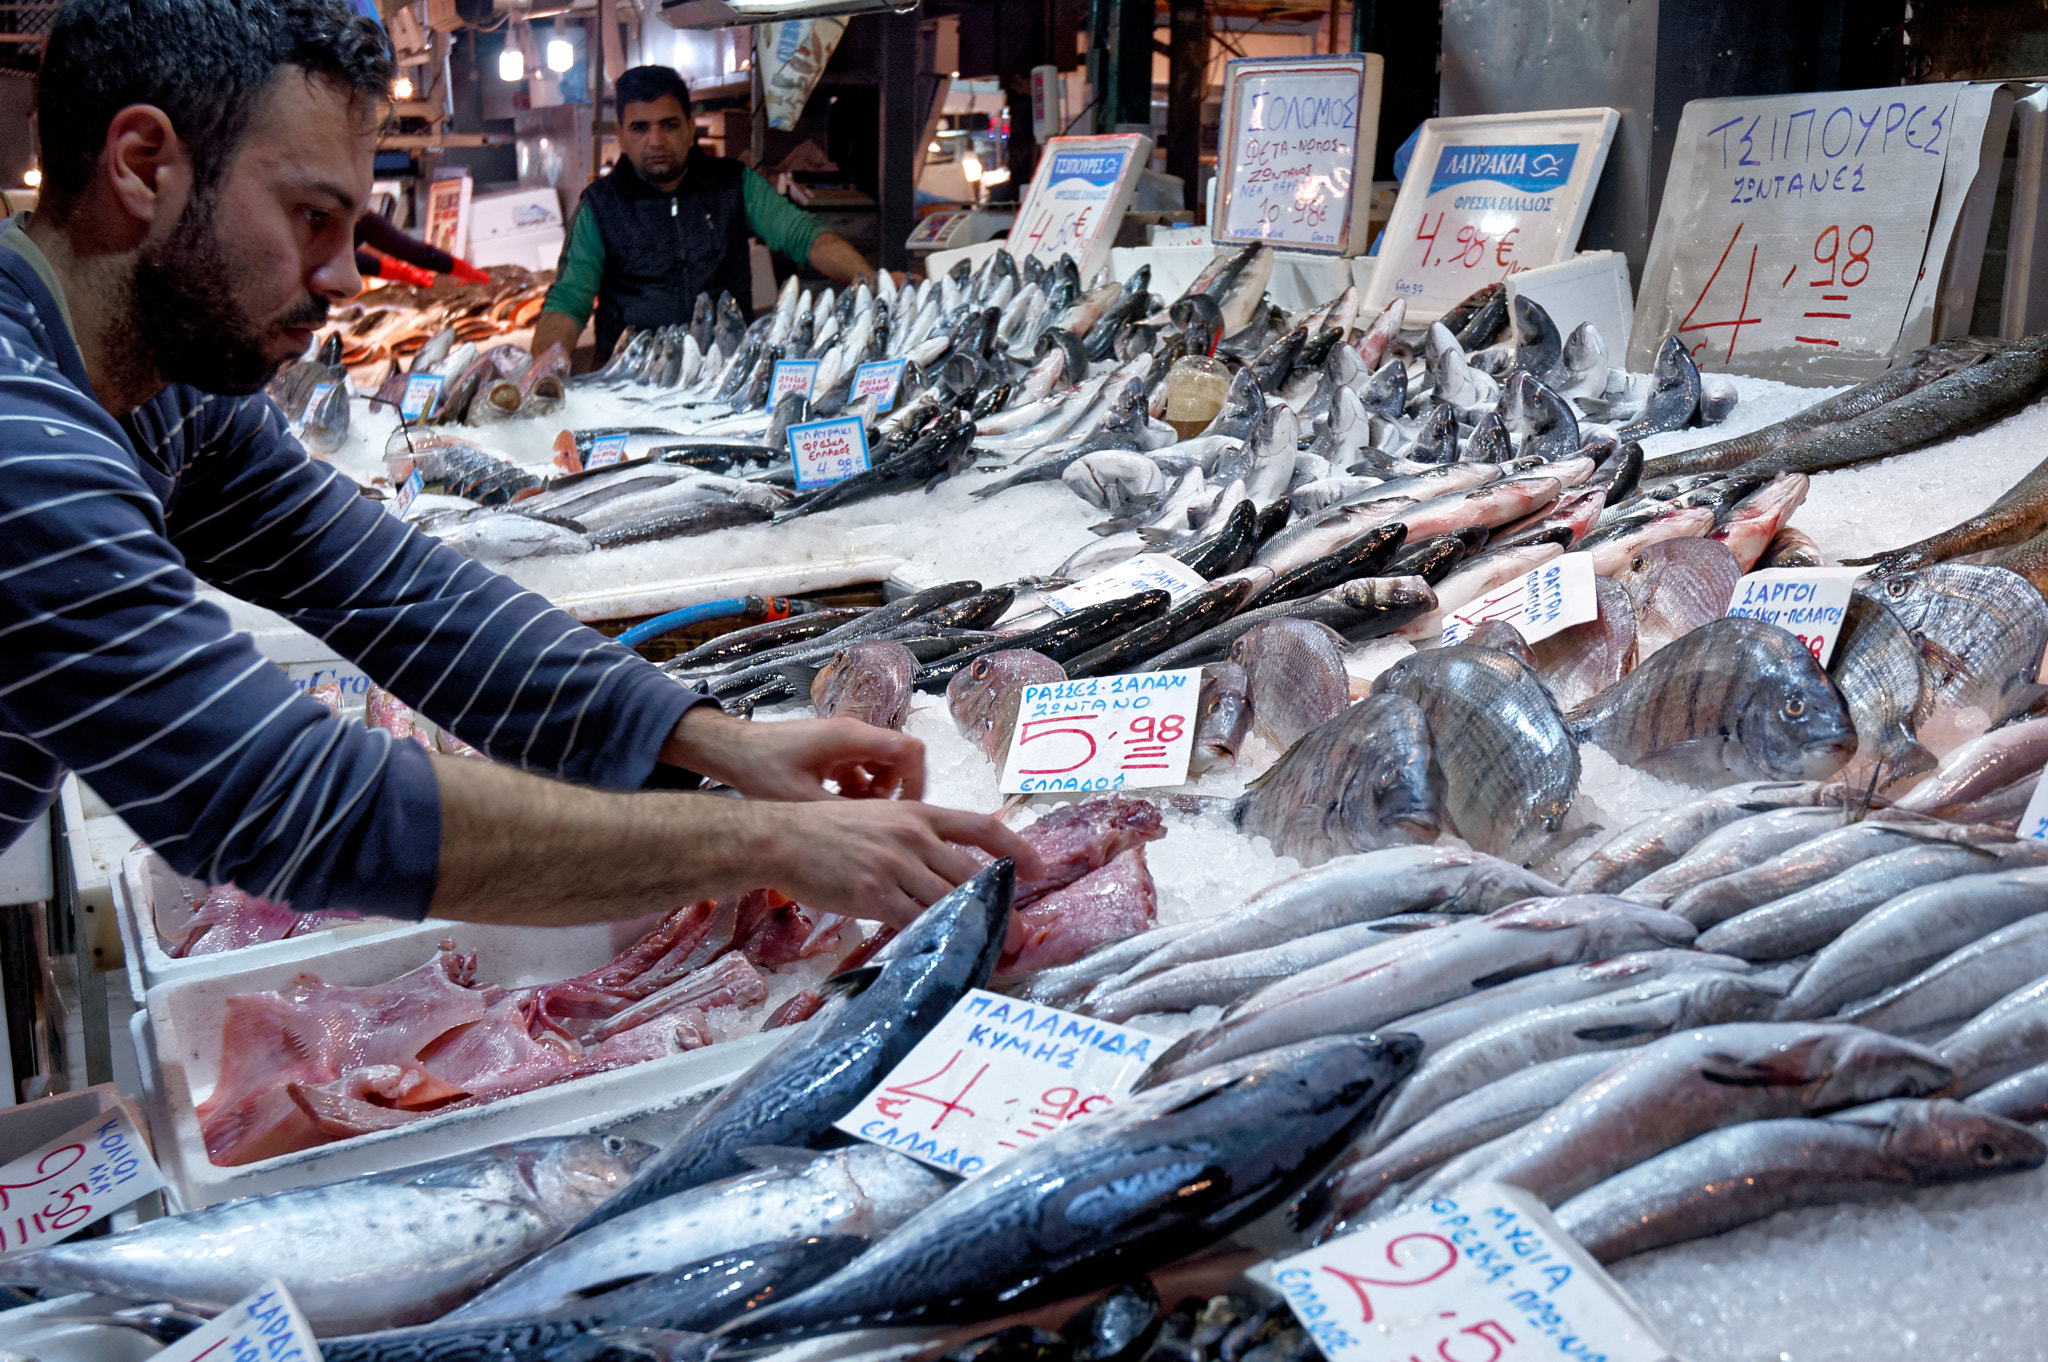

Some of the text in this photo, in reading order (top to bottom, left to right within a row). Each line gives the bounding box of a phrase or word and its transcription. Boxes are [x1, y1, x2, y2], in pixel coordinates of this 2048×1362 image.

[1708, 102, 1949, 169] ΤΣΙΠΟΥΡΕΣ
[1444, 152, 1526, 175] ΛΑΥΡΑΚΙΑ
[1453, 195, 1554, 212] ΦΡΕΣΚΑ ΕΛΛΑΔΟΣ
[802, 437, 845, 452] ΦΡΕΣΚΑ
[803, 427, 852, 440] ΛΑΥΡΑΚΙ
[1742, 581, 1818, 606] ΣΑΡΓΟΙ
[964, 996, 1151, 1062] ΠΑΛΑΜΙΔΑ
[967, 1023, 1080, 1070] ΚΥΜΗΣ
[95, 1117, 140, 1186] ΚΟΛΙΟΙ
